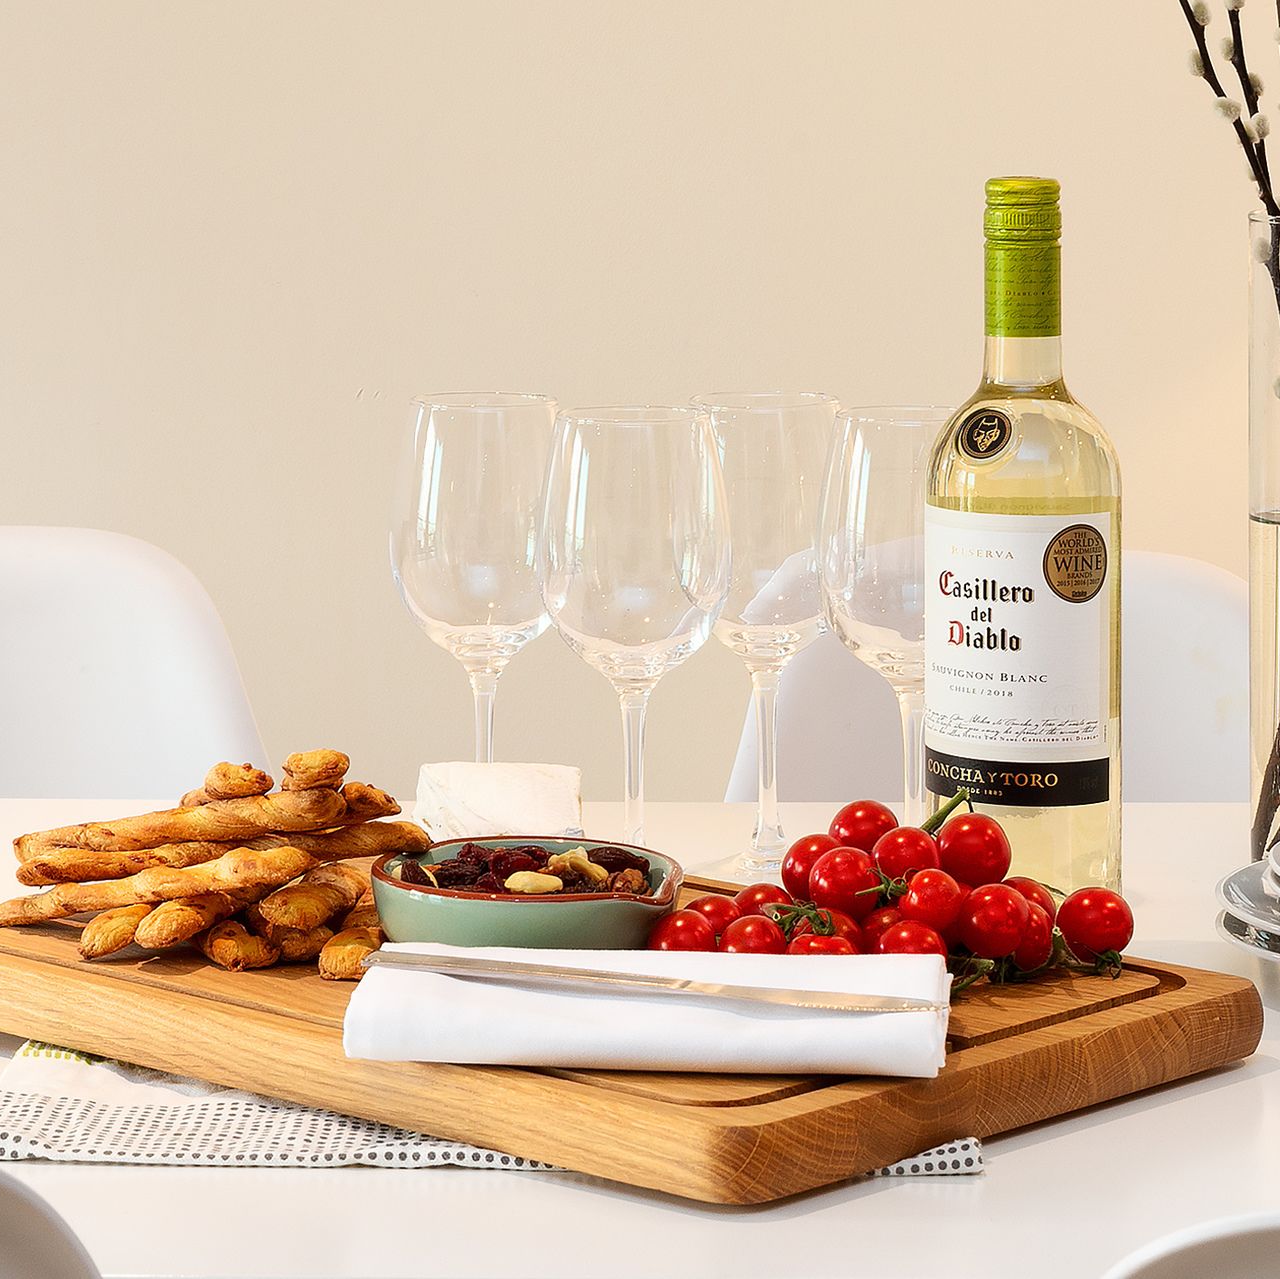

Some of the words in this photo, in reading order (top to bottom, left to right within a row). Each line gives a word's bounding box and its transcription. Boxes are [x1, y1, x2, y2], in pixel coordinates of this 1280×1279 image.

[1053, 554, 1102, 573] WINE
[939, 569, 1035, 604] Casillero
[970, 605, 992, 623] del
[947, 620, 1022, 652] Diablo
[928, 757, 985, 784] CONCHA
[987, 771, 998, 783] Y
[1000, 772, 1059, 788] TORO
